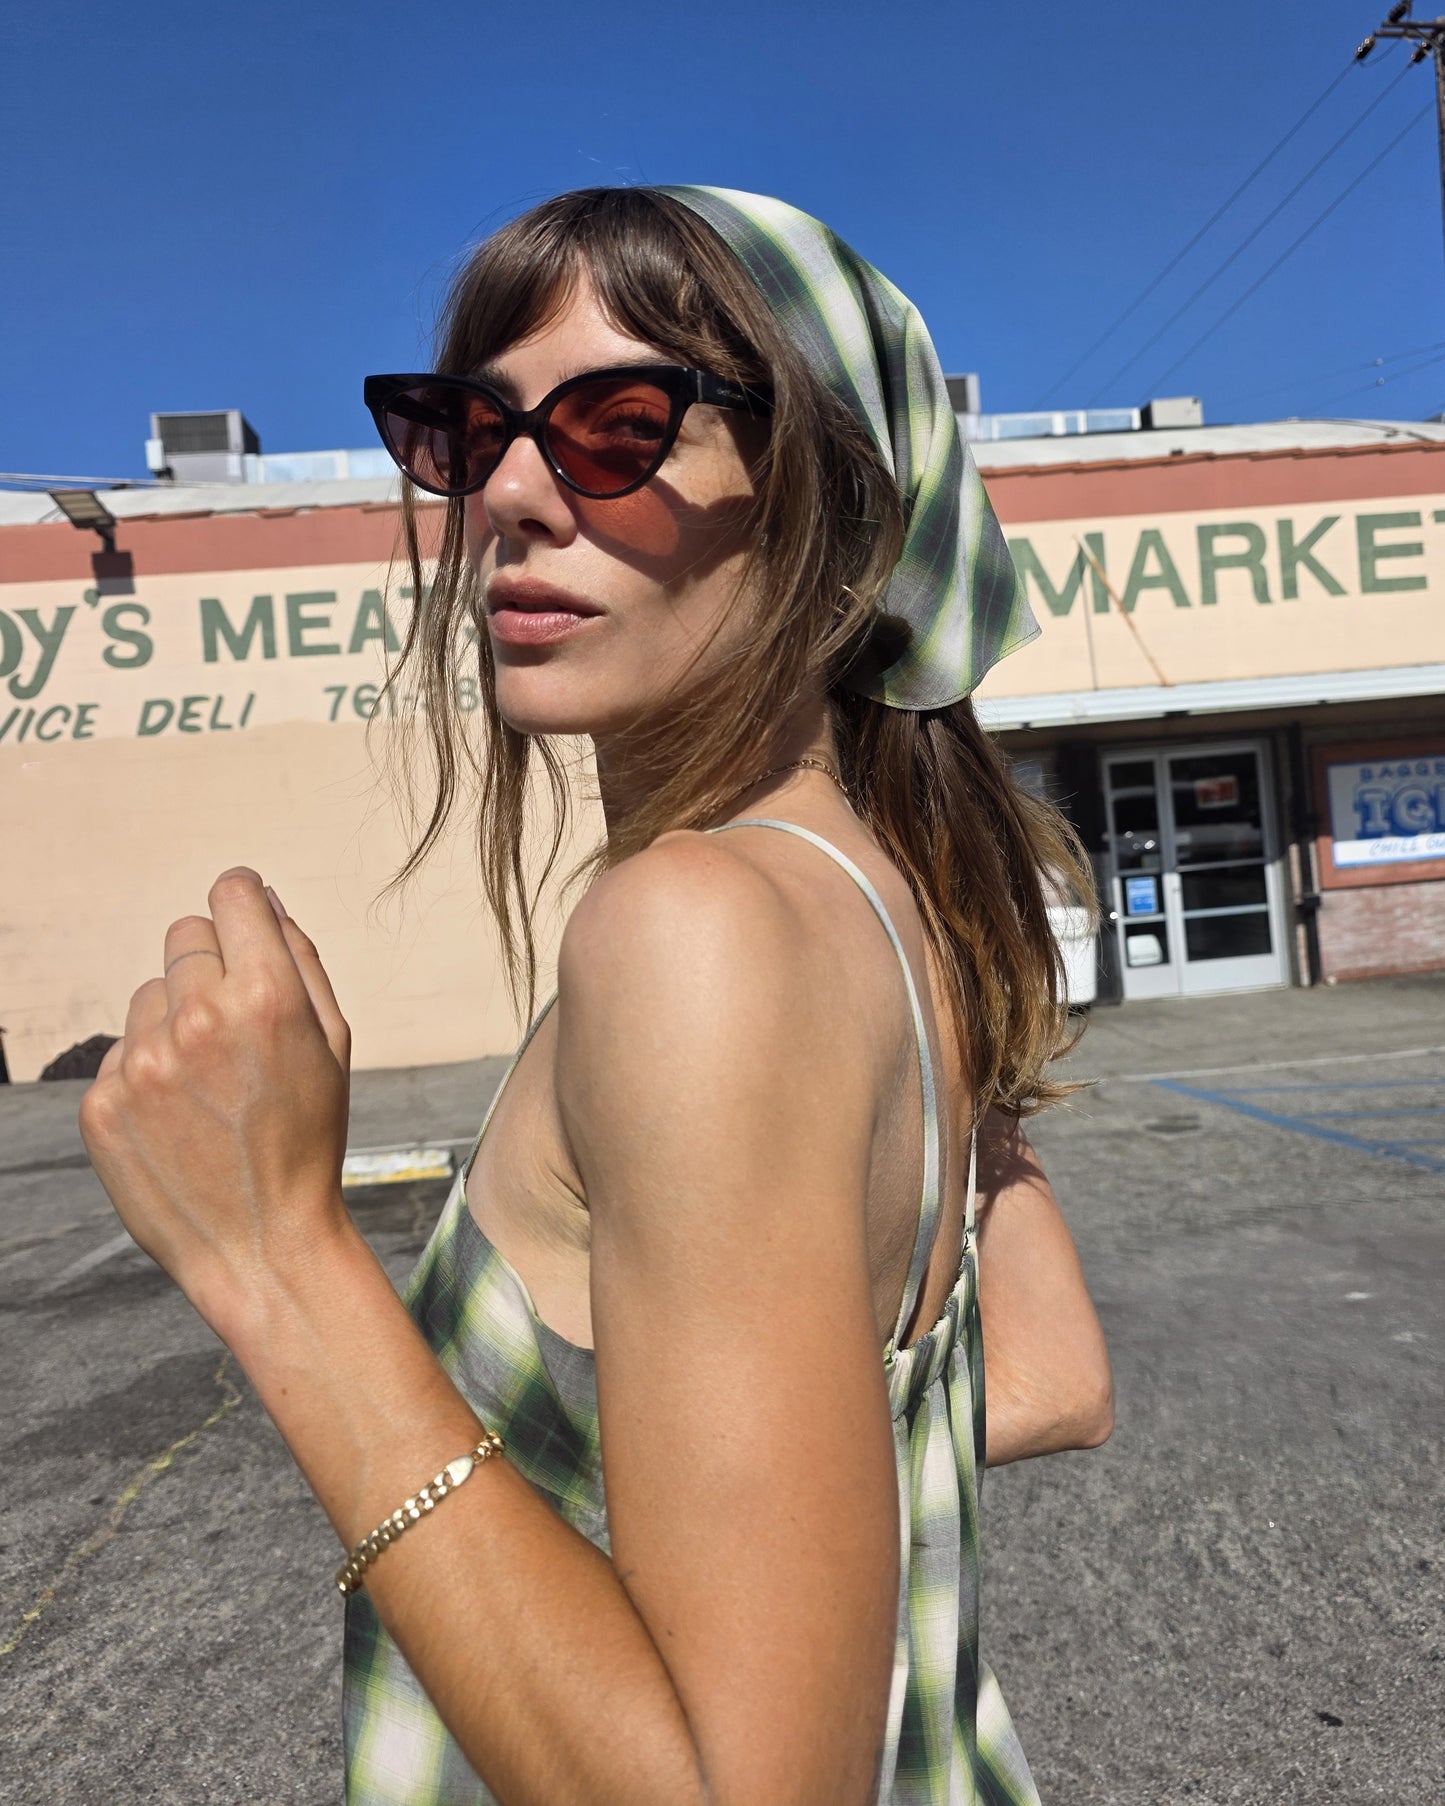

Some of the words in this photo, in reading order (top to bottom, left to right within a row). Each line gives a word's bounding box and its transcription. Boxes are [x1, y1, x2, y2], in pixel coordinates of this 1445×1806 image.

[1008, 510, 1445, 616] MARKE
[137, 693, 255, 737] DELI
[1354, 786, 1445, 838] IC
